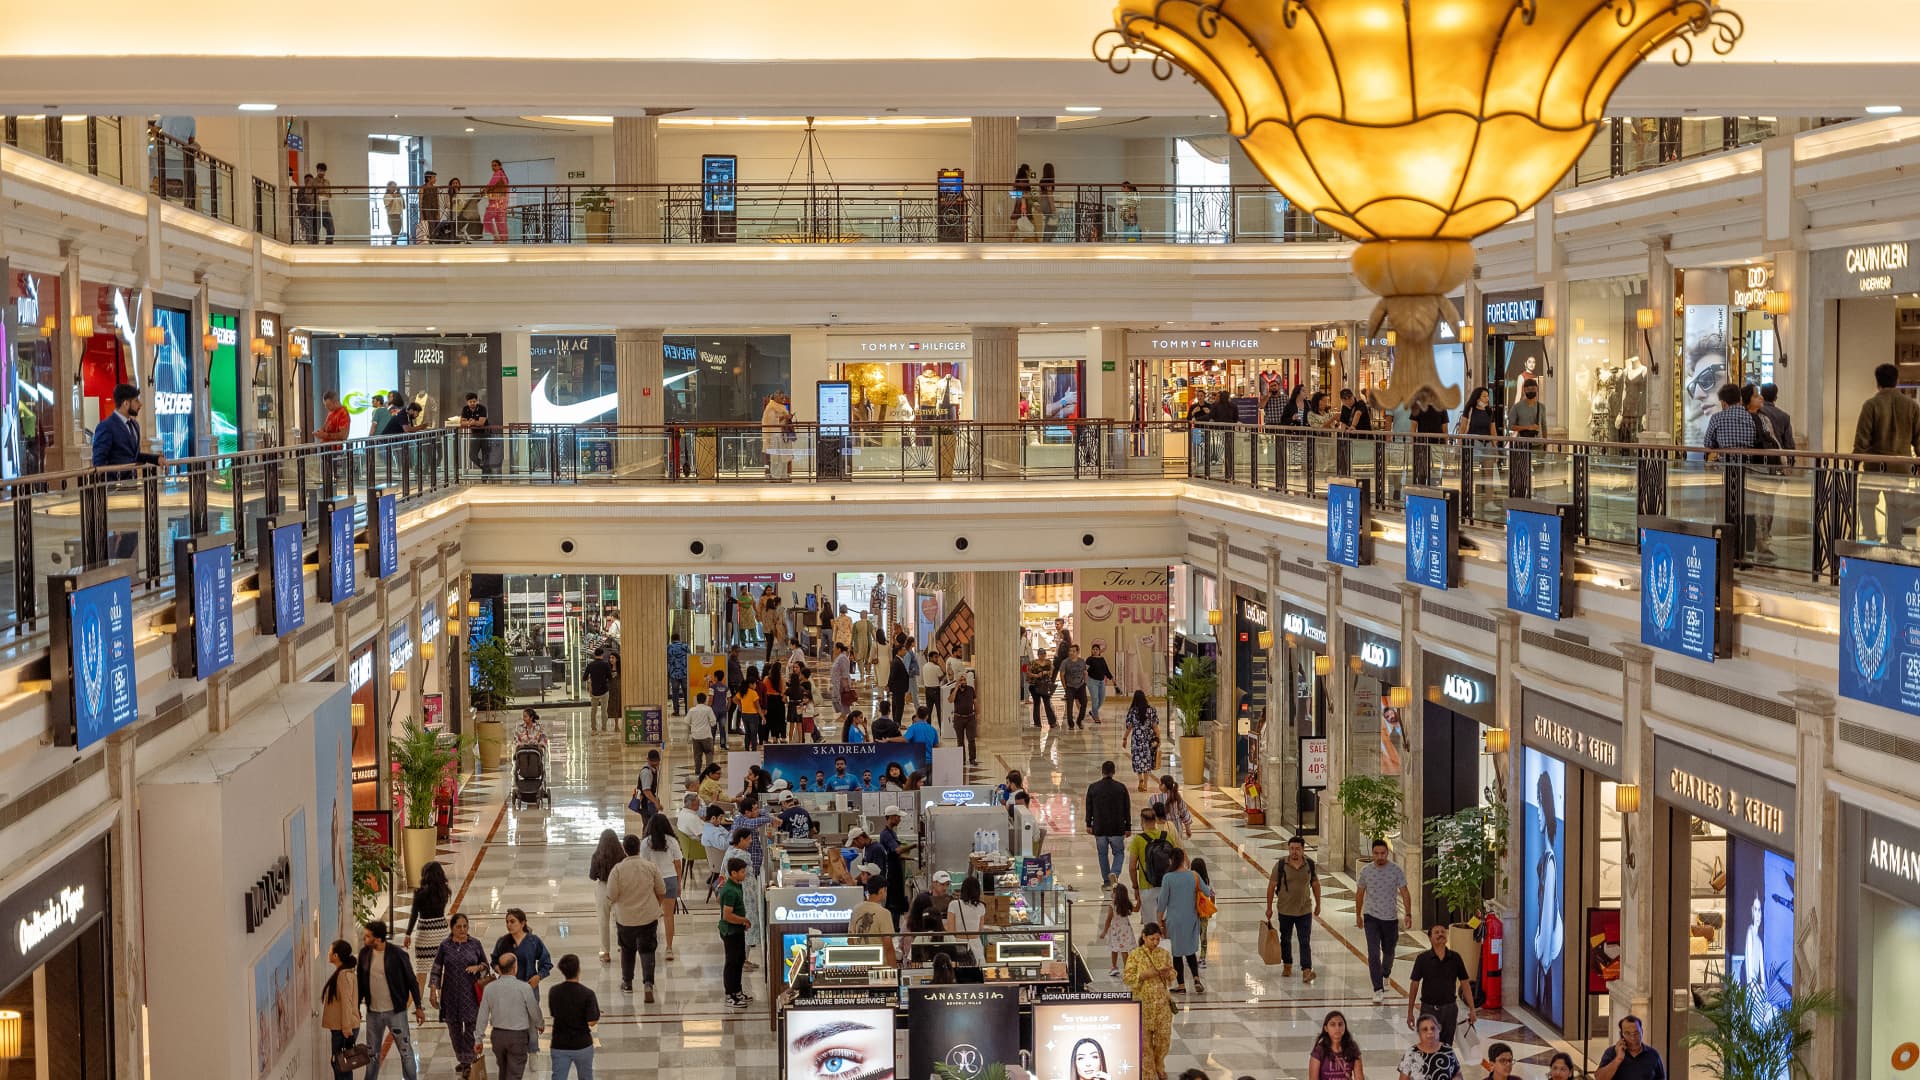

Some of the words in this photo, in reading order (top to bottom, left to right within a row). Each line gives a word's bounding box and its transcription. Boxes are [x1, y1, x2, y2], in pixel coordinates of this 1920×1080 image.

[1846, 247, 1879, 273] CALVIN
[1880, 243, 1908, 269] KLEIN
[1860, 275, 1891, 291] UNDERWEAR
[1488, 301, 1519, 322] FOREVER
[1520, 300, 1536, 319] NEW
[861, 343, 906, 351] TOMMY
[922, 342, 967, 350] HILFIGER
[1152, 340, 1198, 348] TOMMY
[1214, 340, 1259, 348] HILFIGER
[1687, 556, 1702, 570] ORRA
[1103, 570, 1135, 586] Too
[1130, 593, 1163, 601] PROOF
[1283, 613, 1303, 635] ALDO
[1361, 642, 1384, 668] ALDO
[1443, 674, 1473, 704] ALDO
[1309, 744, 1327, 752] SALE
[1534, 715, 1573, 750] CHARLES
[1575, 732, 1584, 754] &
[1587, 736, 1617, 767] KEITH
[821, 746, 835, 754] KA
[838, 745, 876, 754] DREAM
[1669, 768, 1722, 811] CHARLES
[1727, 789, 1737, 816] &
[1744, 797, 1784, 835] KEITH
[1870, 836, 1920, 885] ARMAN
[245, 855, 290, 934] MANGO
[794, 998, 833, 1006] SIGNATURE
[928, 992, 999, 1001] ANASTASIA
